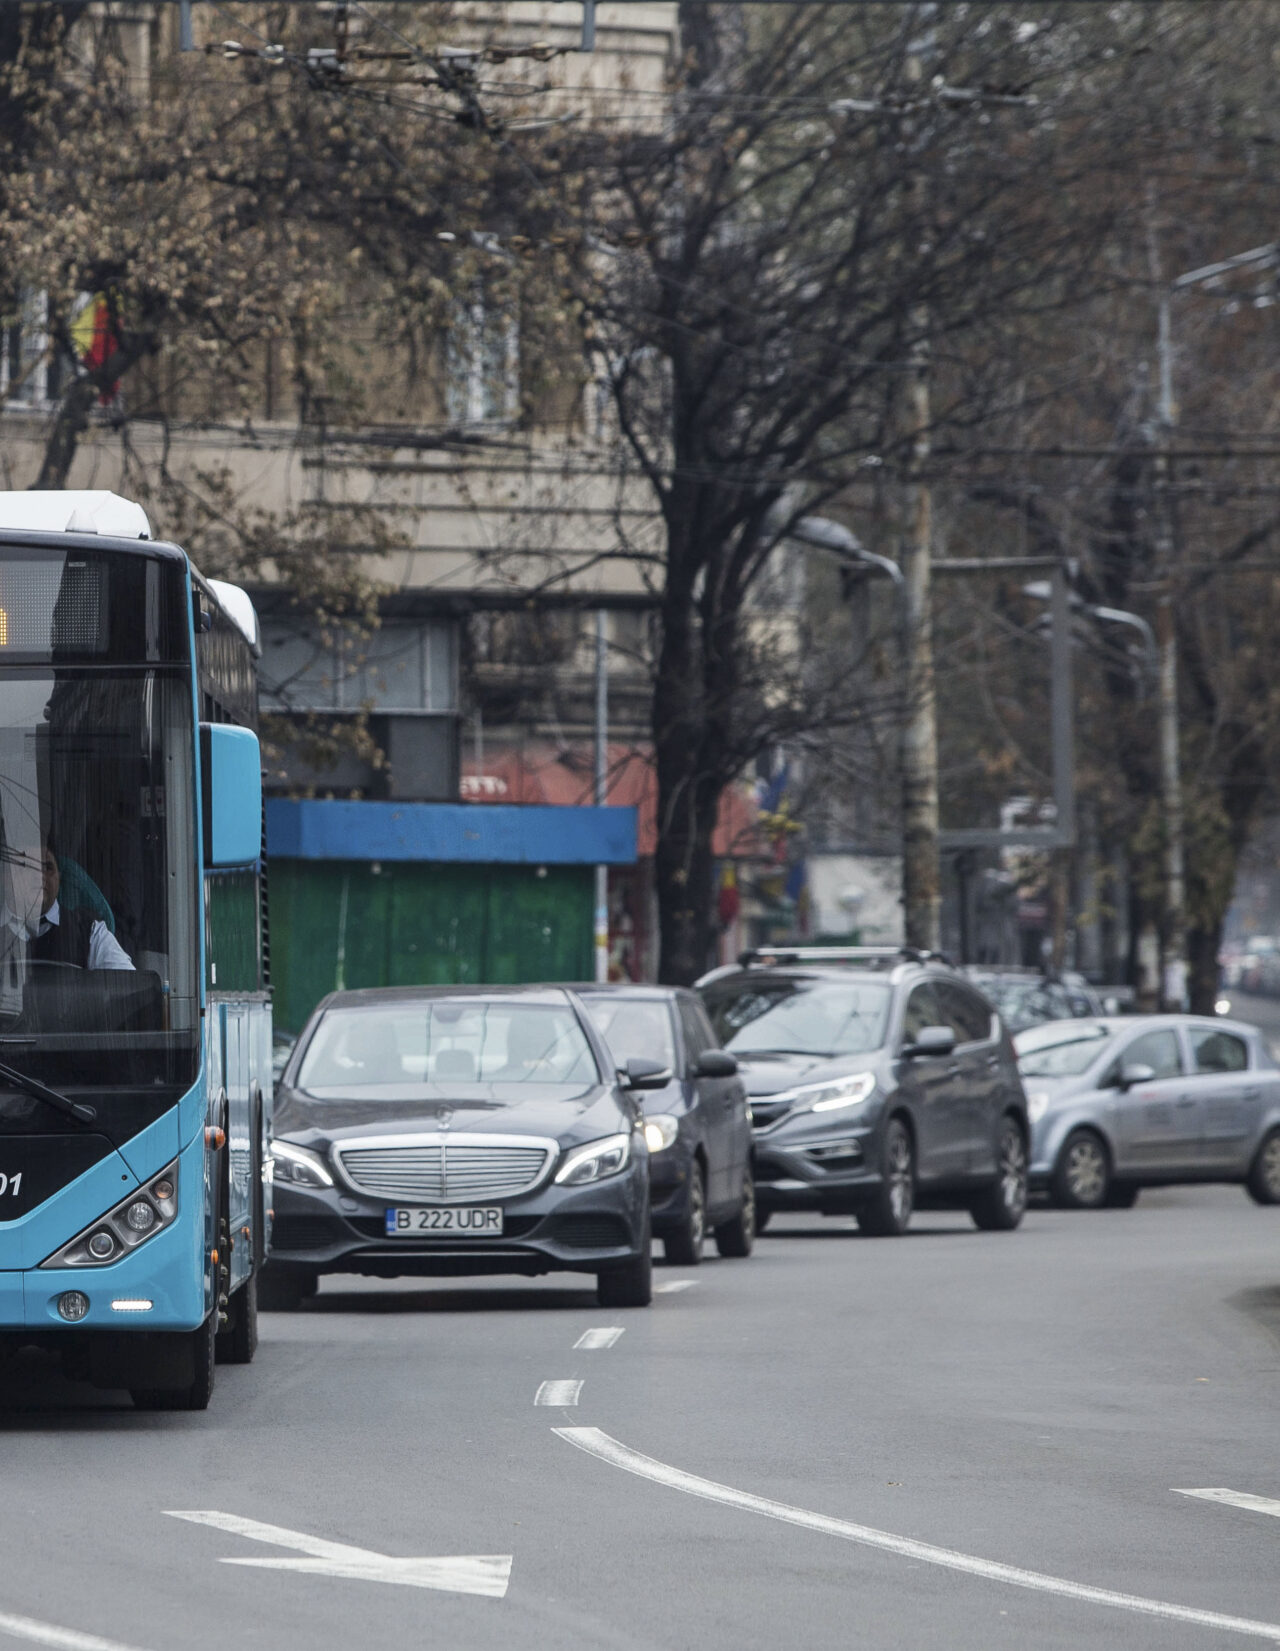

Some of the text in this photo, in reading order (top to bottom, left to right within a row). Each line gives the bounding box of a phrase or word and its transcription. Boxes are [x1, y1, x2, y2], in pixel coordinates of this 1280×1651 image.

[396, 1209, 500, 1229] B 222 UDR
